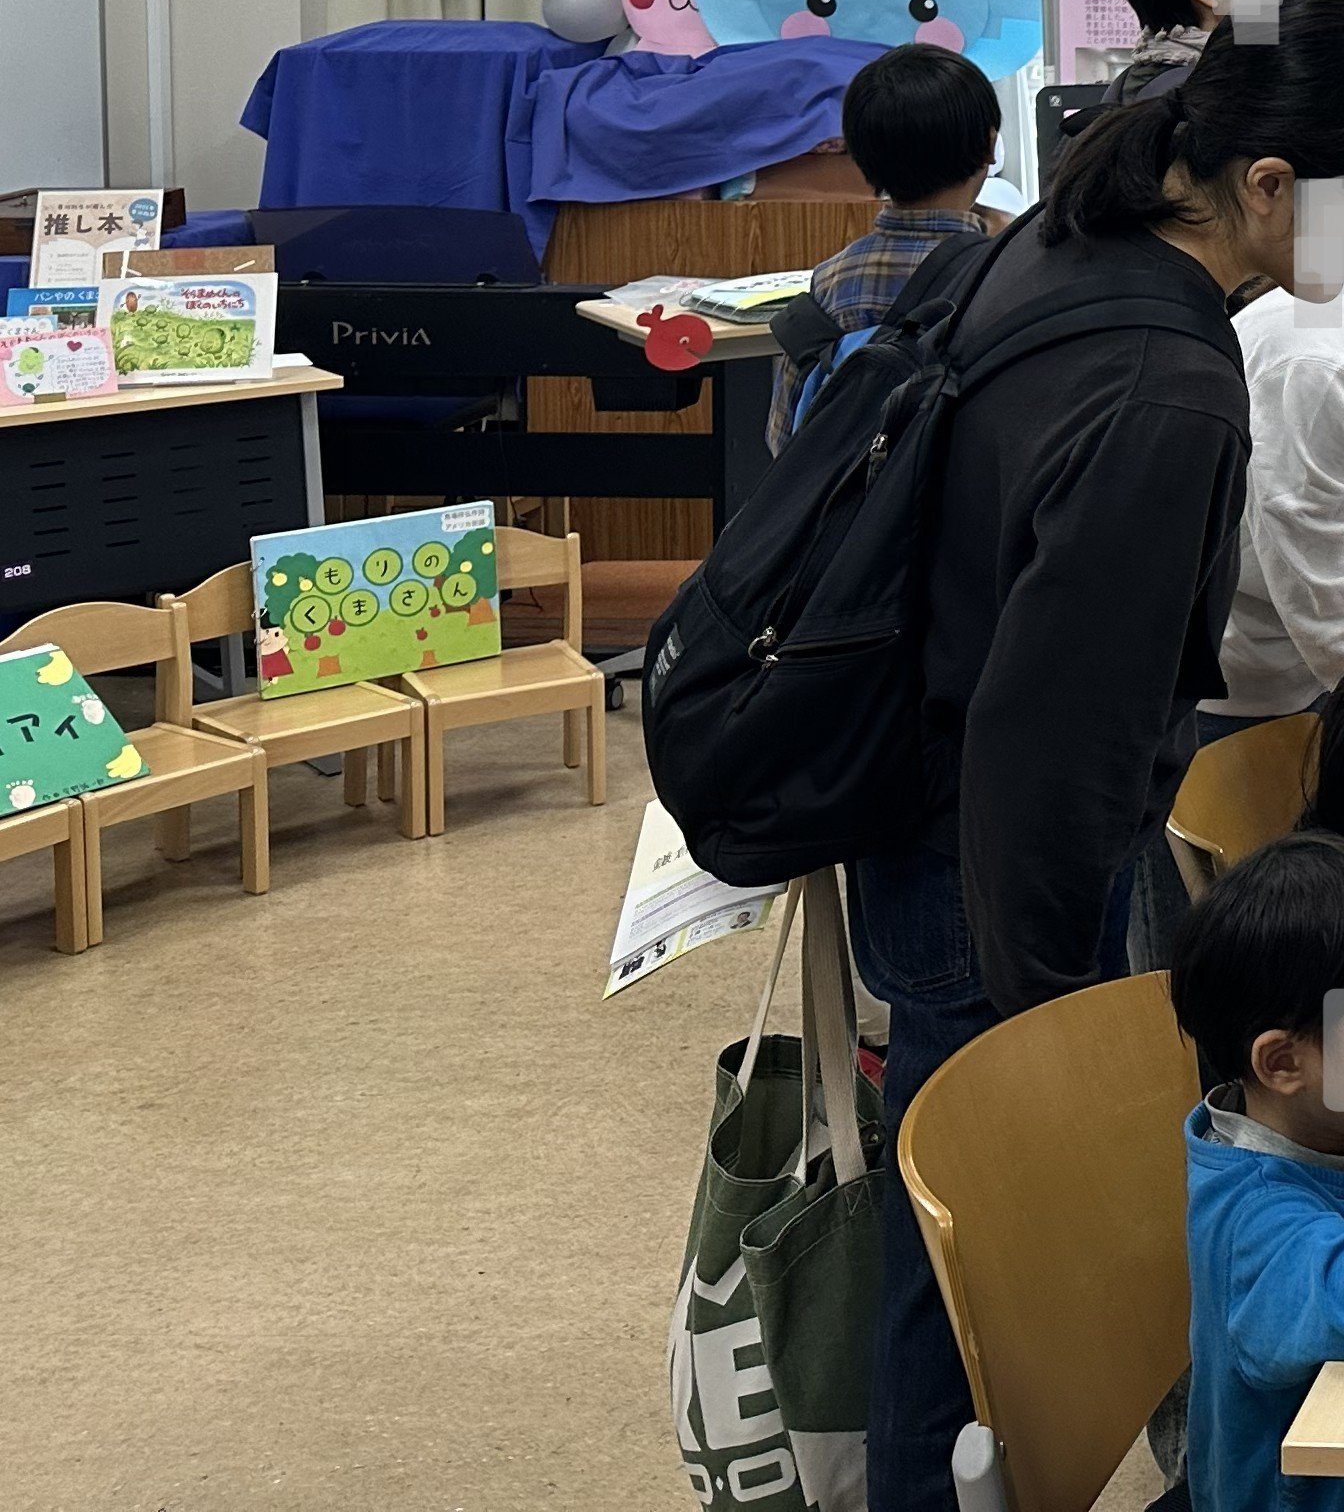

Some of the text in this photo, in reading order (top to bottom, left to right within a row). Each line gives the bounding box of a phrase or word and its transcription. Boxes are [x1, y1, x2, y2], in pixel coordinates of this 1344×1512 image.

[44, 212, 123, 236] 推し本
[325, 553, 440, 585] もりの
[304, 581, 468, 625] くまさん
[0, 714, 79, 756] アイ
